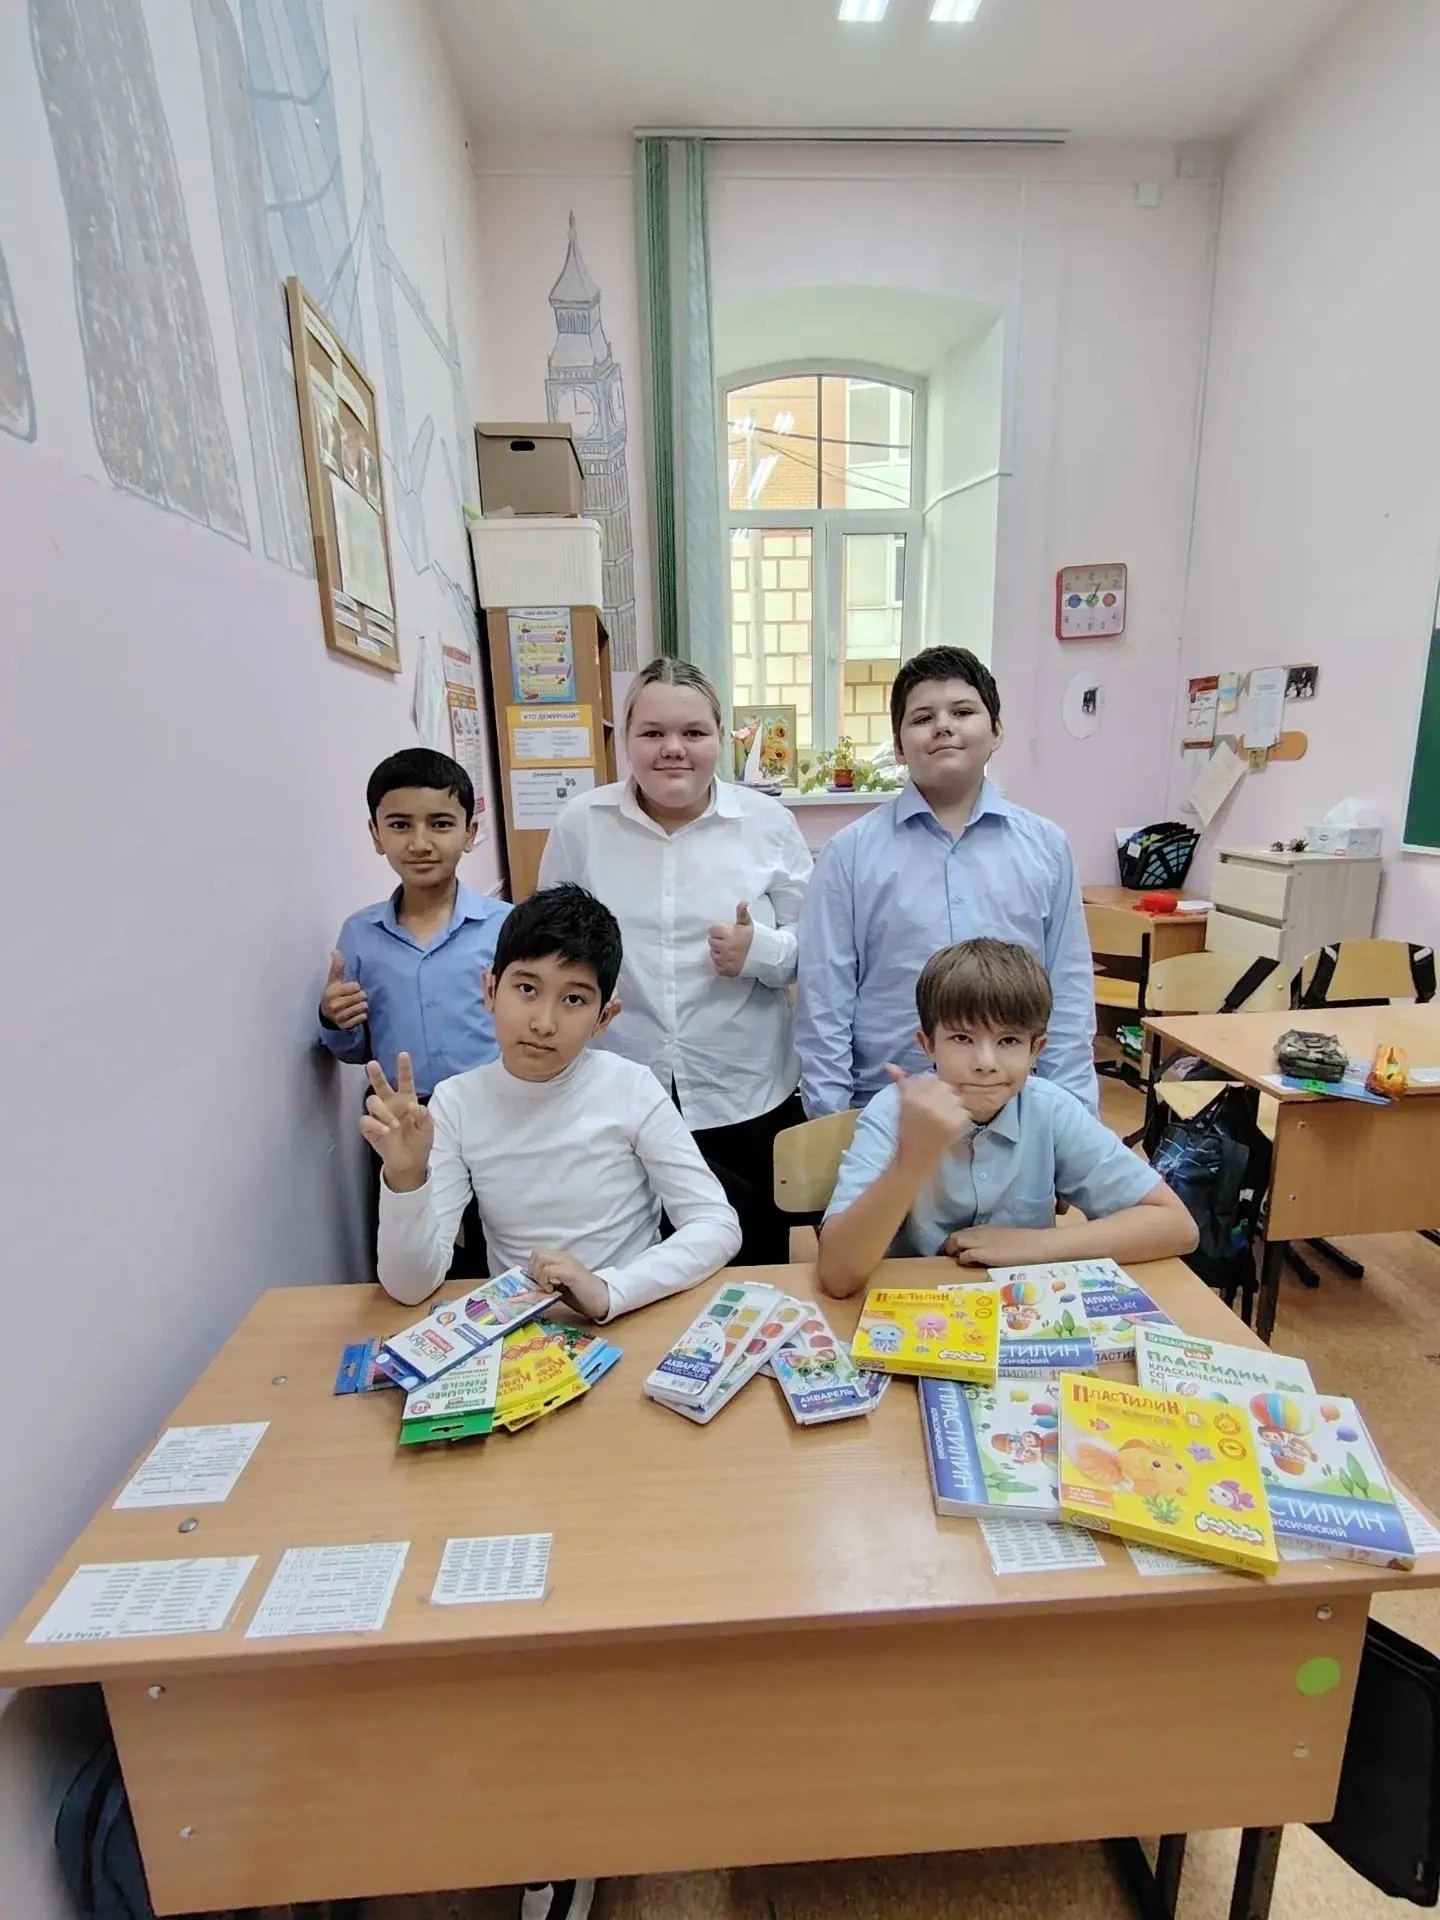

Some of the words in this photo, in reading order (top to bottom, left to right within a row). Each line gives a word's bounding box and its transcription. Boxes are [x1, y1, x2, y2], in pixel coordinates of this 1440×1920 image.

[664, 1359, 711, 1375] АКВАРЕЛЬ
[1147, 1350, 1270, 1384] ПЛАСТИЛИН
[440, 1377, 487, 1390] PENCILS
[800, 1388, 854, 1404] АКВАРЕЛЬ
[1073, 1384, 1180, 1415] ПЛАСТИЛИН
[938, 1387, 973, 1488] ПЛАСТИЛИН
